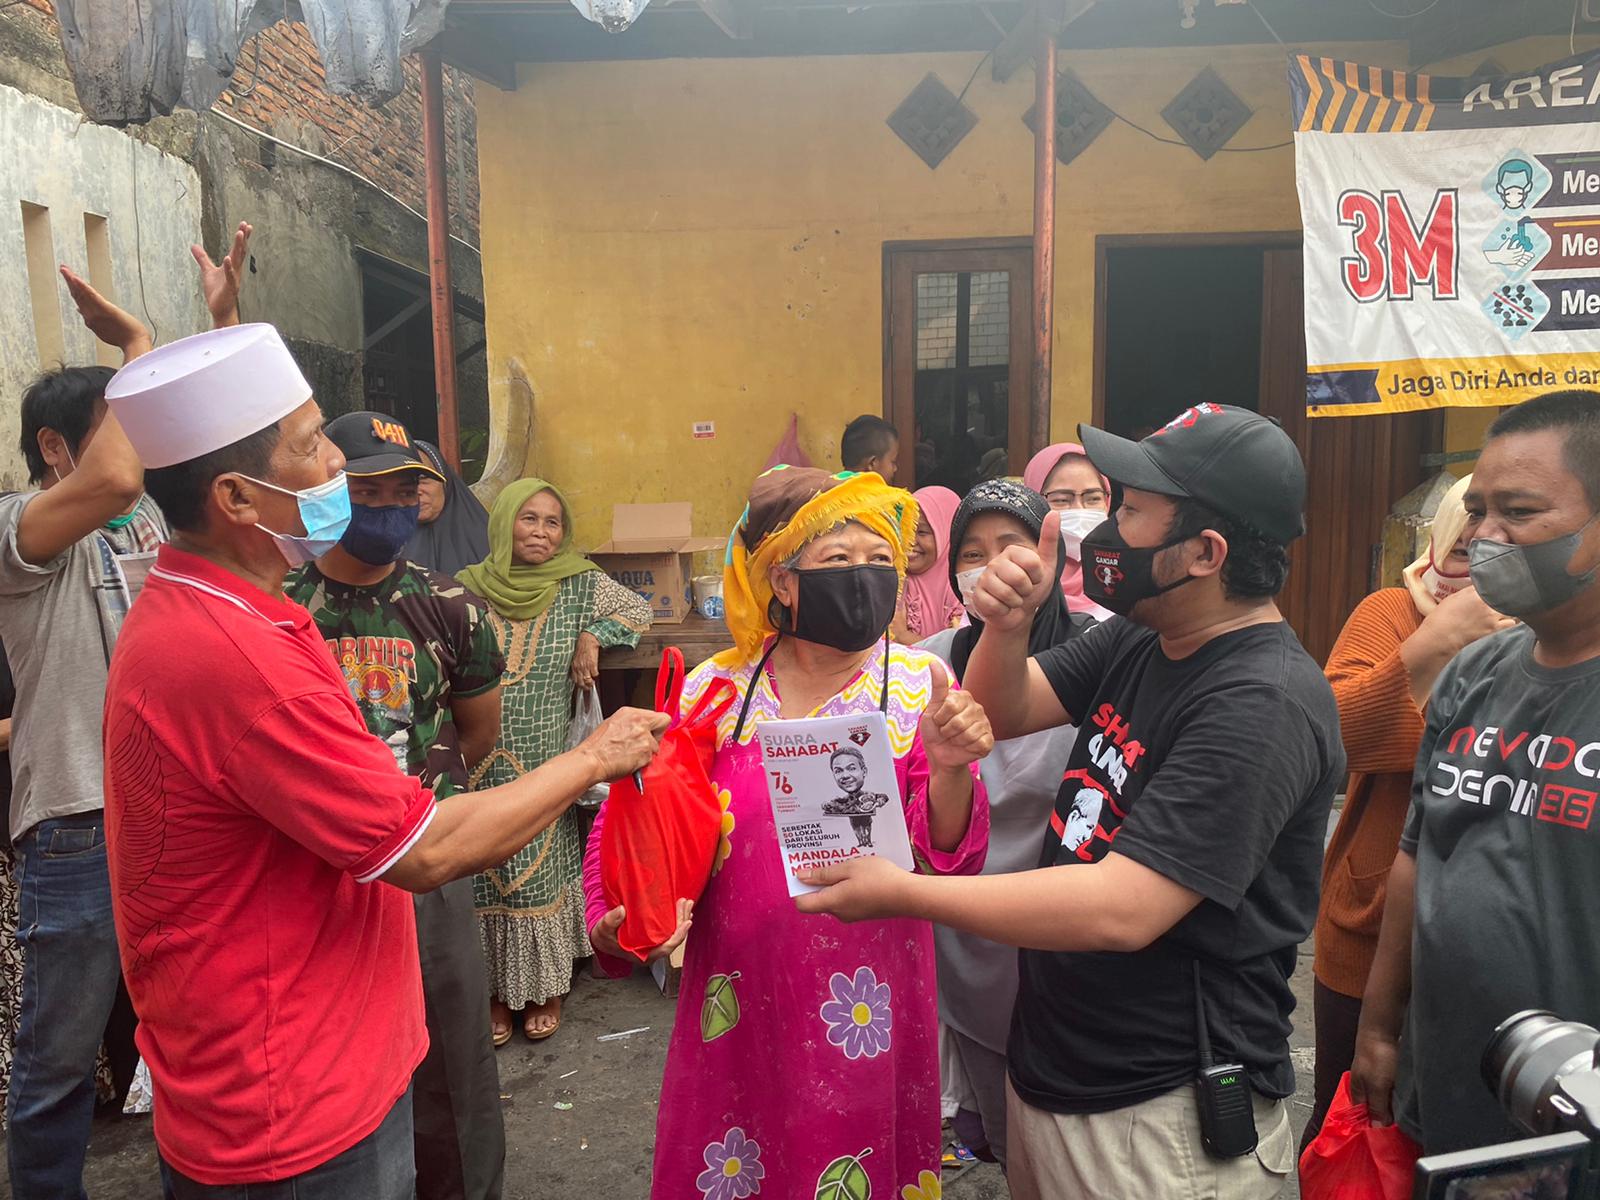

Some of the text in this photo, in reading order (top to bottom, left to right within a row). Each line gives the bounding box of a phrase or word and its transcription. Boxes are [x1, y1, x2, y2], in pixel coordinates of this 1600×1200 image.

[1337, 187, 1459, 303] 3M
[1387, 373, 1447, 397] Jaga
[1450, 369, 1490, 391] Diri
[1495, 366, 1557, 389] Anda
[611, 570, 656, 589] AQUA
[325, 635, 418, 684] ARINIR
[763, 734, 816, 745] SUARA
[766, 743, 838, 757] SAHABAT
[770, 771, 793, 794] 76
[781, 823, 821, 833] SERENTAK
[795, 829, 823, 837] LOKASI
[804, 833, 840, 842] SELURUH
[786, 841, 822, 850] PROVINSI
[789, 847, 859, 863] MANDALA
